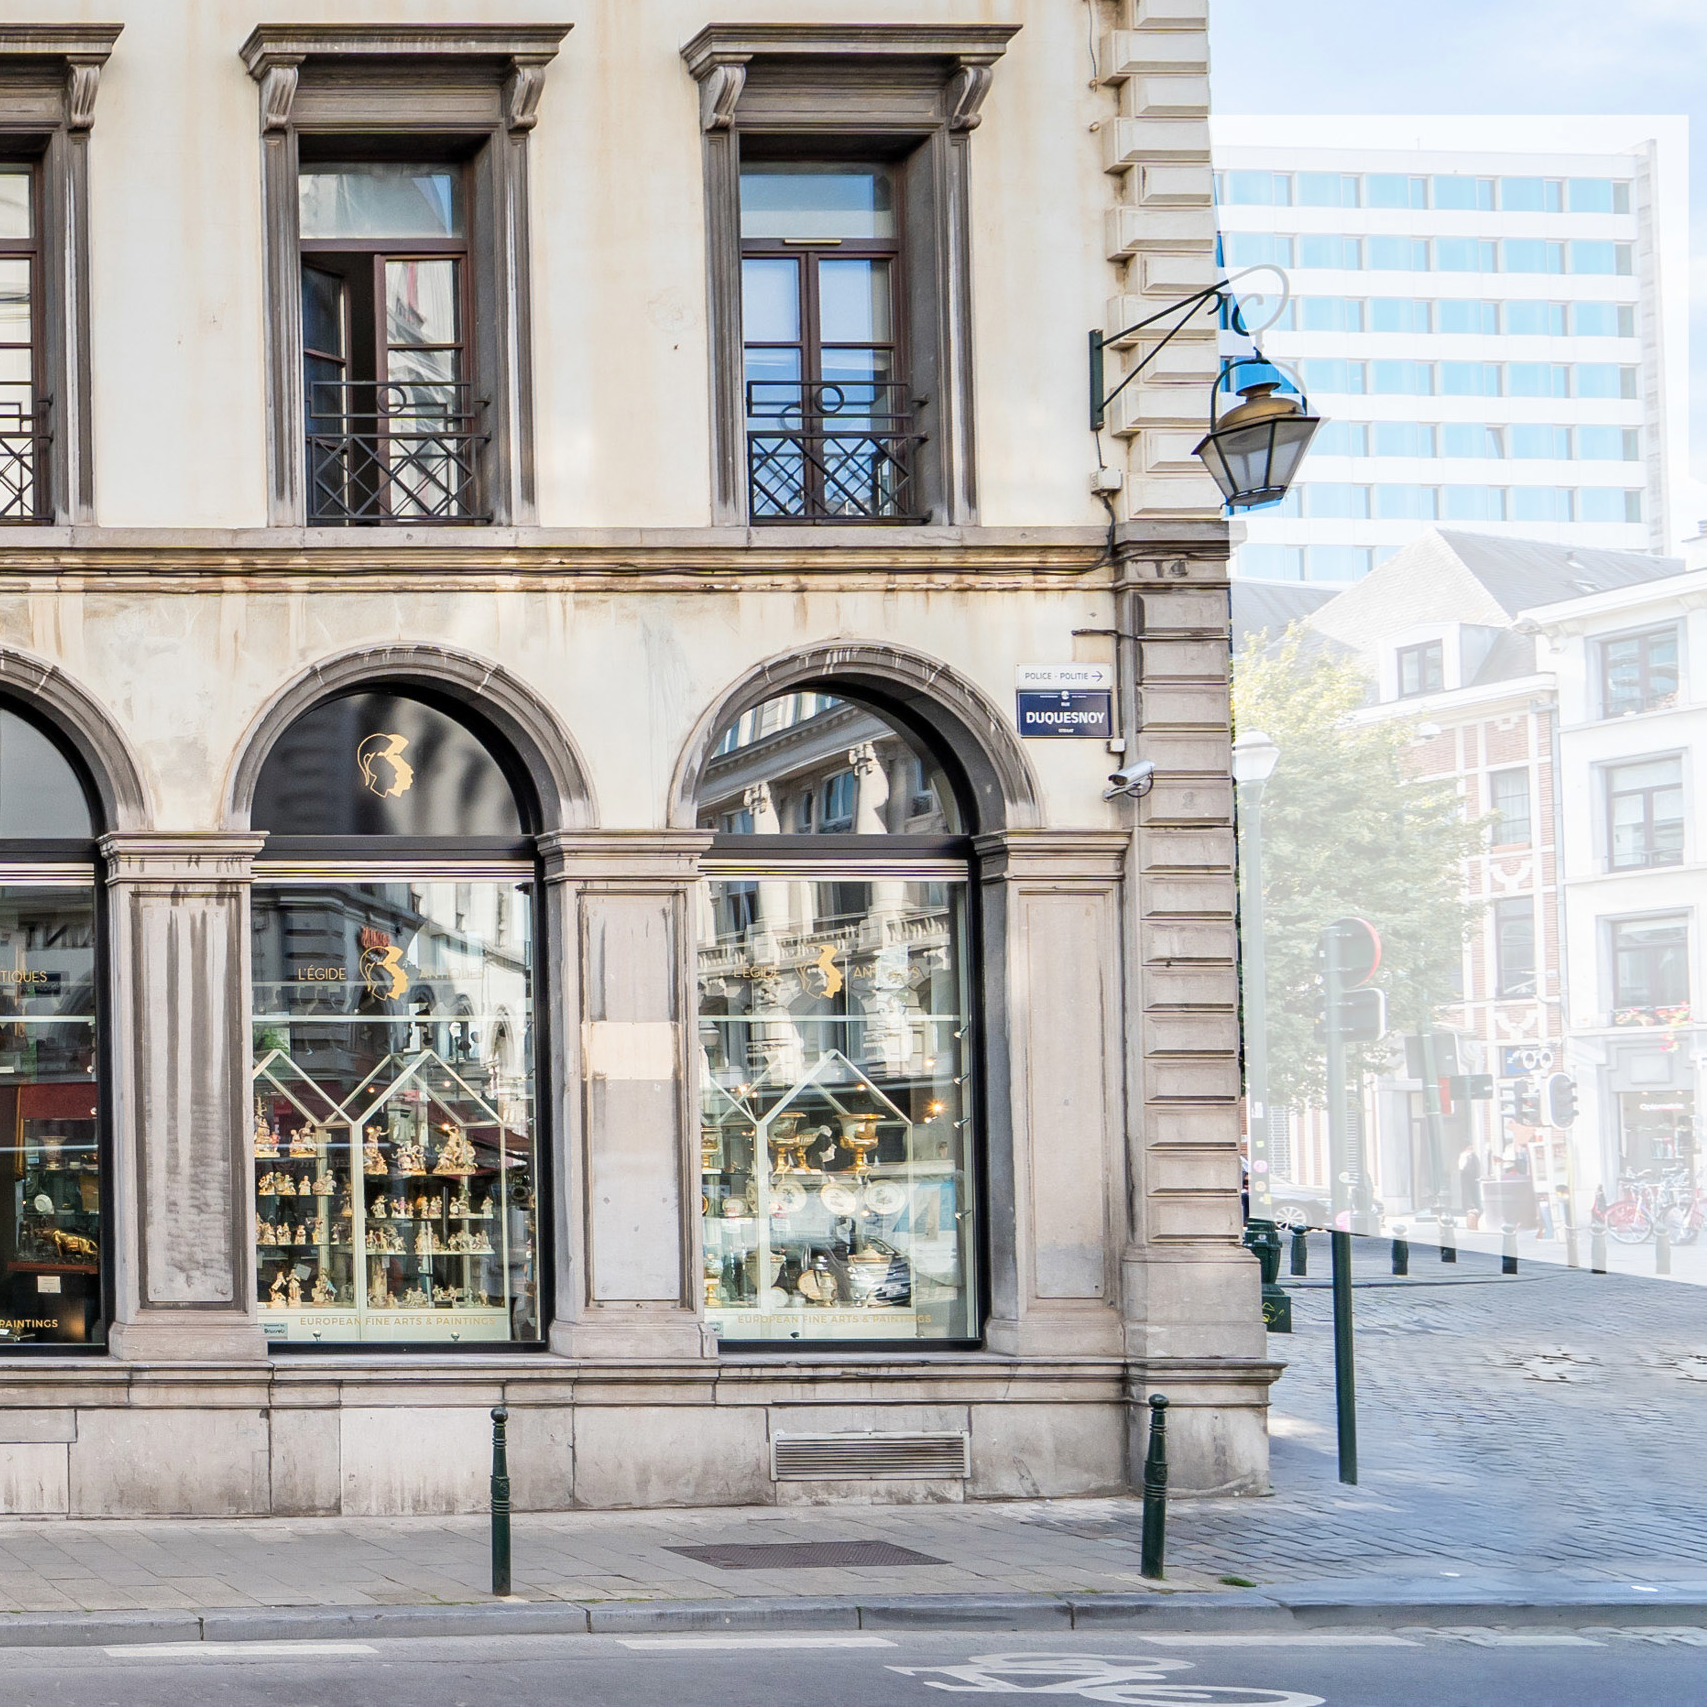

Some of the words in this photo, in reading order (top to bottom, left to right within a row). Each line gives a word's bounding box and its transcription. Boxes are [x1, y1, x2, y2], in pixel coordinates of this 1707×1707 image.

[1024, 672, 1052, 680] POLICE
[1060, 672, 1089, 680] POLITIE
[1025, 711, 1105, 725] DUQUESNOY
[298, 965, 347, 981] L'ÉGIDE
[300, 1317, 361, 1326] EUROPEAN
[365, 1317, 390, 1326] FINE
[393, 1317, 422, 1326] ARTS
[436, 1317, 496, 1326] PAINTINGS
[738, 1315, 799, 1324] EUROPEAN
[802, 1315, 827, 1324] FINE
[831, 1315, 859, 1324] ARTS
